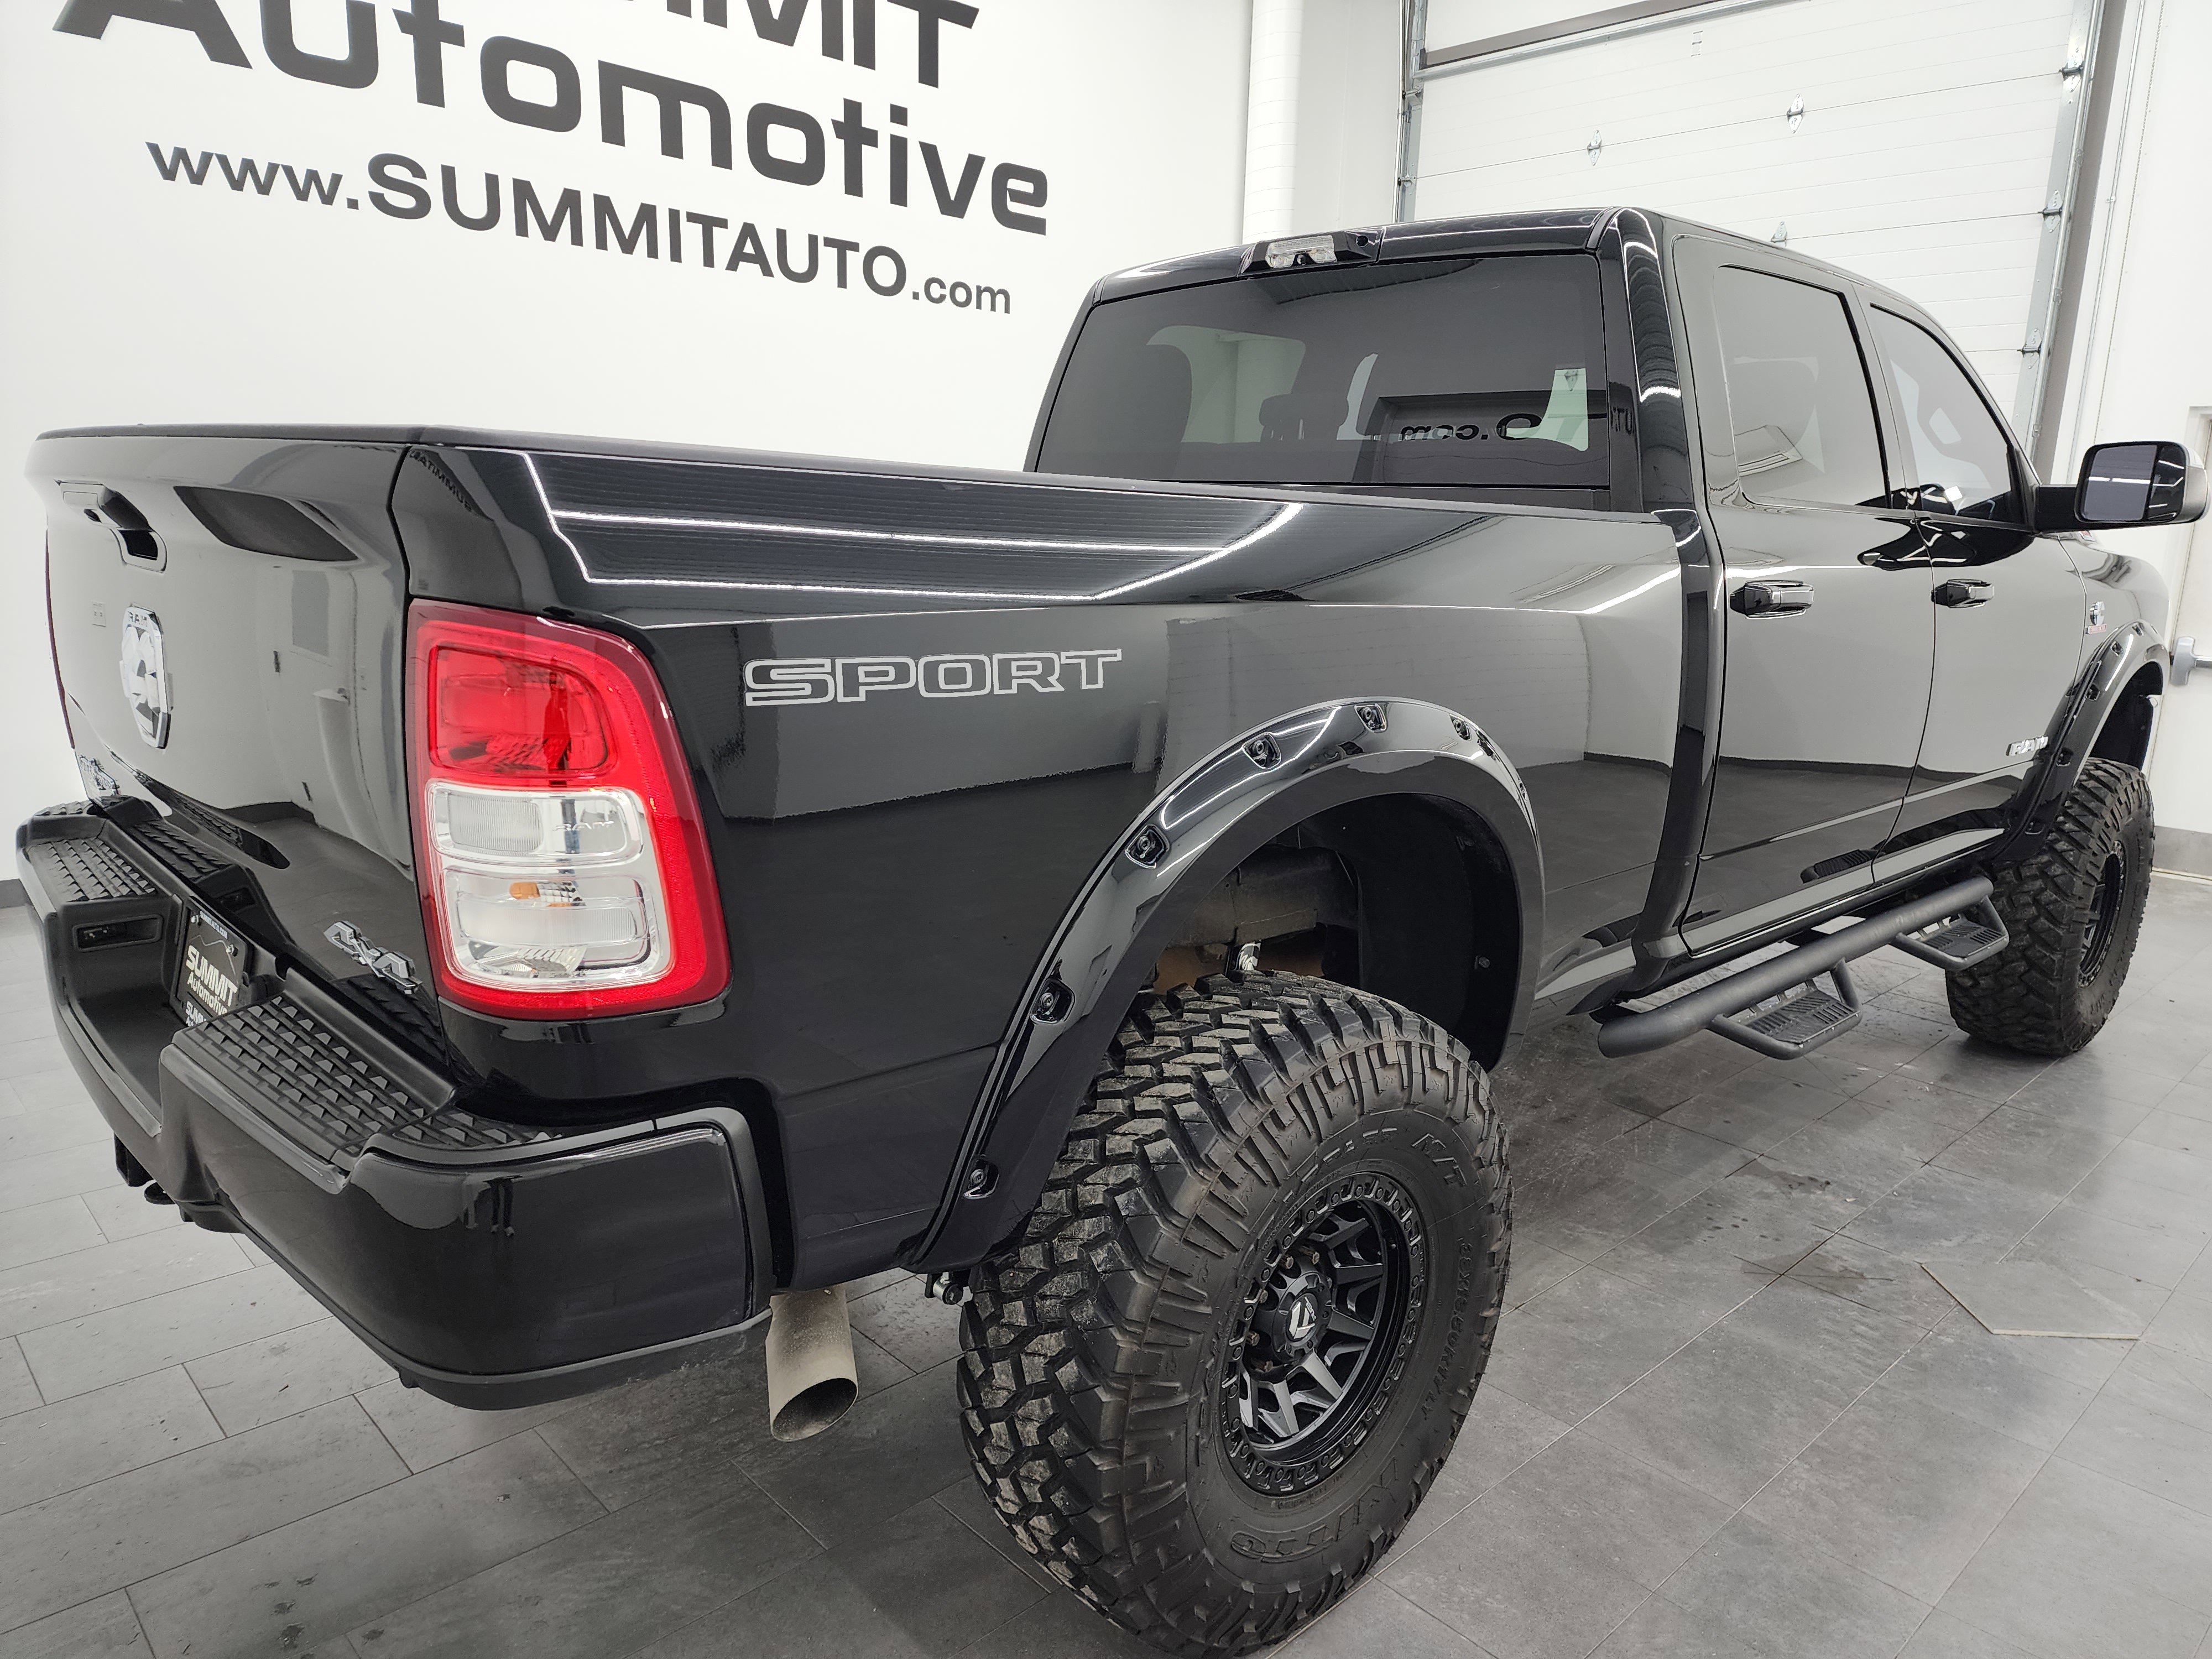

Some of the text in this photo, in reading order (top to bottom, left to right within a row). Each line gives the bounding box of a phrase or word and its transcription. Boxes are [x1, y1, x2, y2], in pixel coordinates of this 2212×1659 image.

[630, 0, 979, 88] MIT
[145, 142, 1010, 314] www.SUMMITAUTO.com
[128, 611, 148, 627] RAM
[745, 649, 1122, 706] SPORT
[186, 945, 238, 1007] SUMMIT
[187, 972, 227, 1016] Automotive
[185, 1000, 207, 1025] SUMM
